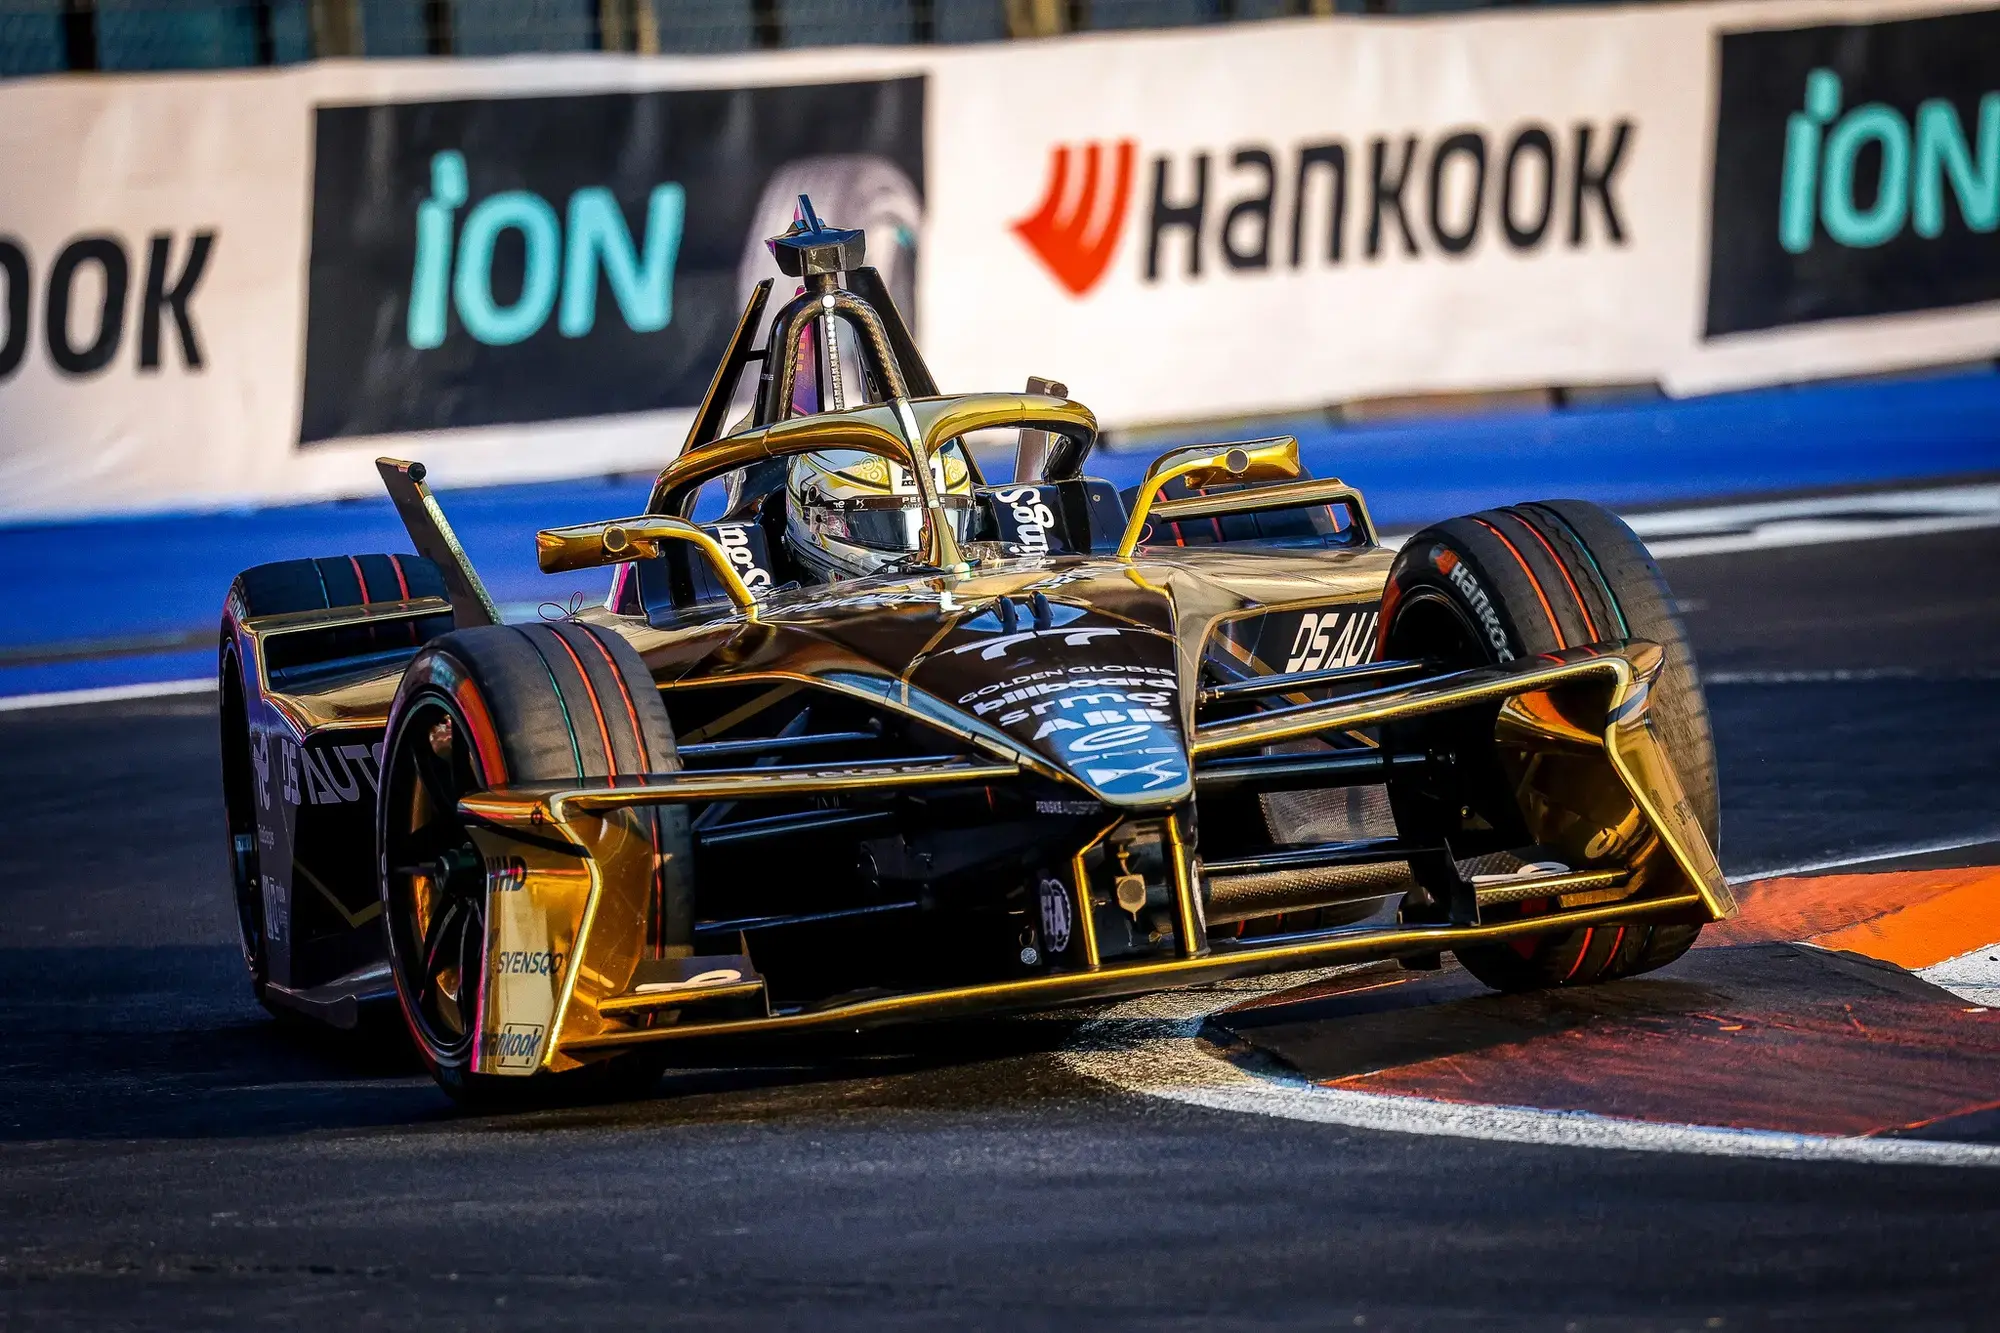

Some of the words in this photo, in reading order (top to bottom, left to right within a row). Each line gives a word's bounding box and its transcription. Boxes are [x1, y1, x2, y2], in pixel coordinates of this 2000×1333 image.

[407, 149, 686, 349] iON
[957, 668, 1064, 705] GOLDEN
[1067, 664, 1177, 677] GLOBES
[972, 677, 1178, 717] billboard
[1032, 708, 1172, 741] ABB
[498, 951, 564, 977] SYENSQO
